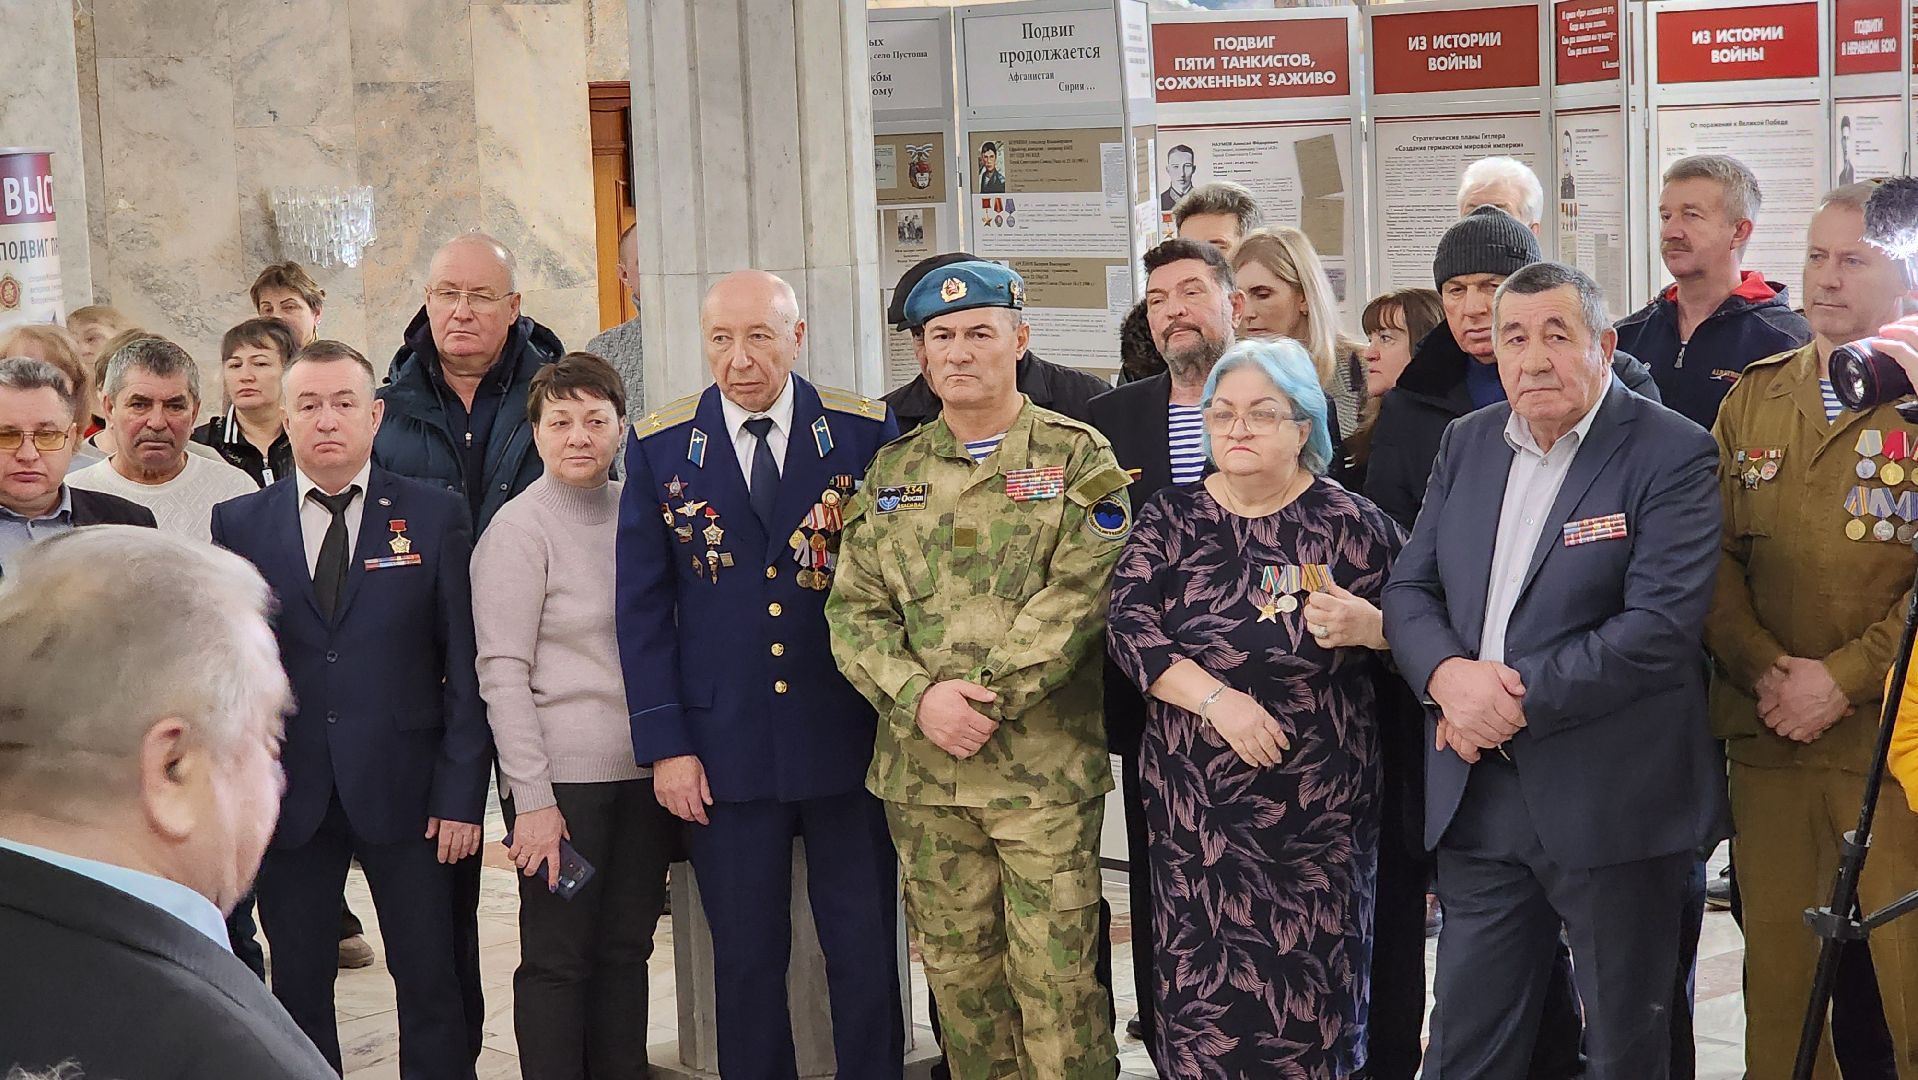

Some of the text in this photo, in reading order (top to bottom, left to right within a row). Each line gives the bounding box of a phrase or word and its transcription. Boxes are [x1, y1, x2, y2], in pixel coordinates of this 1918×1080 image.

[1022, 22, 1075, 40] Подвиг
[1691, 25, 1784, 45] ИЗ ИСТОРИИ
[1213, 35, 1276, 51] ПОДВИГ
[1408, 31, 1501, 51] ИЗ ИСТОРИИ
[999, 45, 1101, 68] продолжается
[1174, 53, 1316, 71] ПЯТИ ТАНКИСТОВ,
[1427, 52, 1482, 71] ВОЙНЫ
[1711, 44, 1765, 64] ВОЙНЫ
[1007, 71, 1055, 83] Афганистан
[1155, 70, 1337, 91] СОЖЖЕННЫХ ЗАЖИВО
[1058, 82, 1085, 93] Сирия
[1412, 134, 1460, 143] Стратегические
[1481, 132, 1506, 141] Гитлера
[1427, 143, 1463, 152] германской
[1464, 142, 1491, 151] мировой
[3, 175, 55, 217] ВЫС
[0, 238, 48, 264] ПОДВИГ
[903, 485, 923, 495] 334
